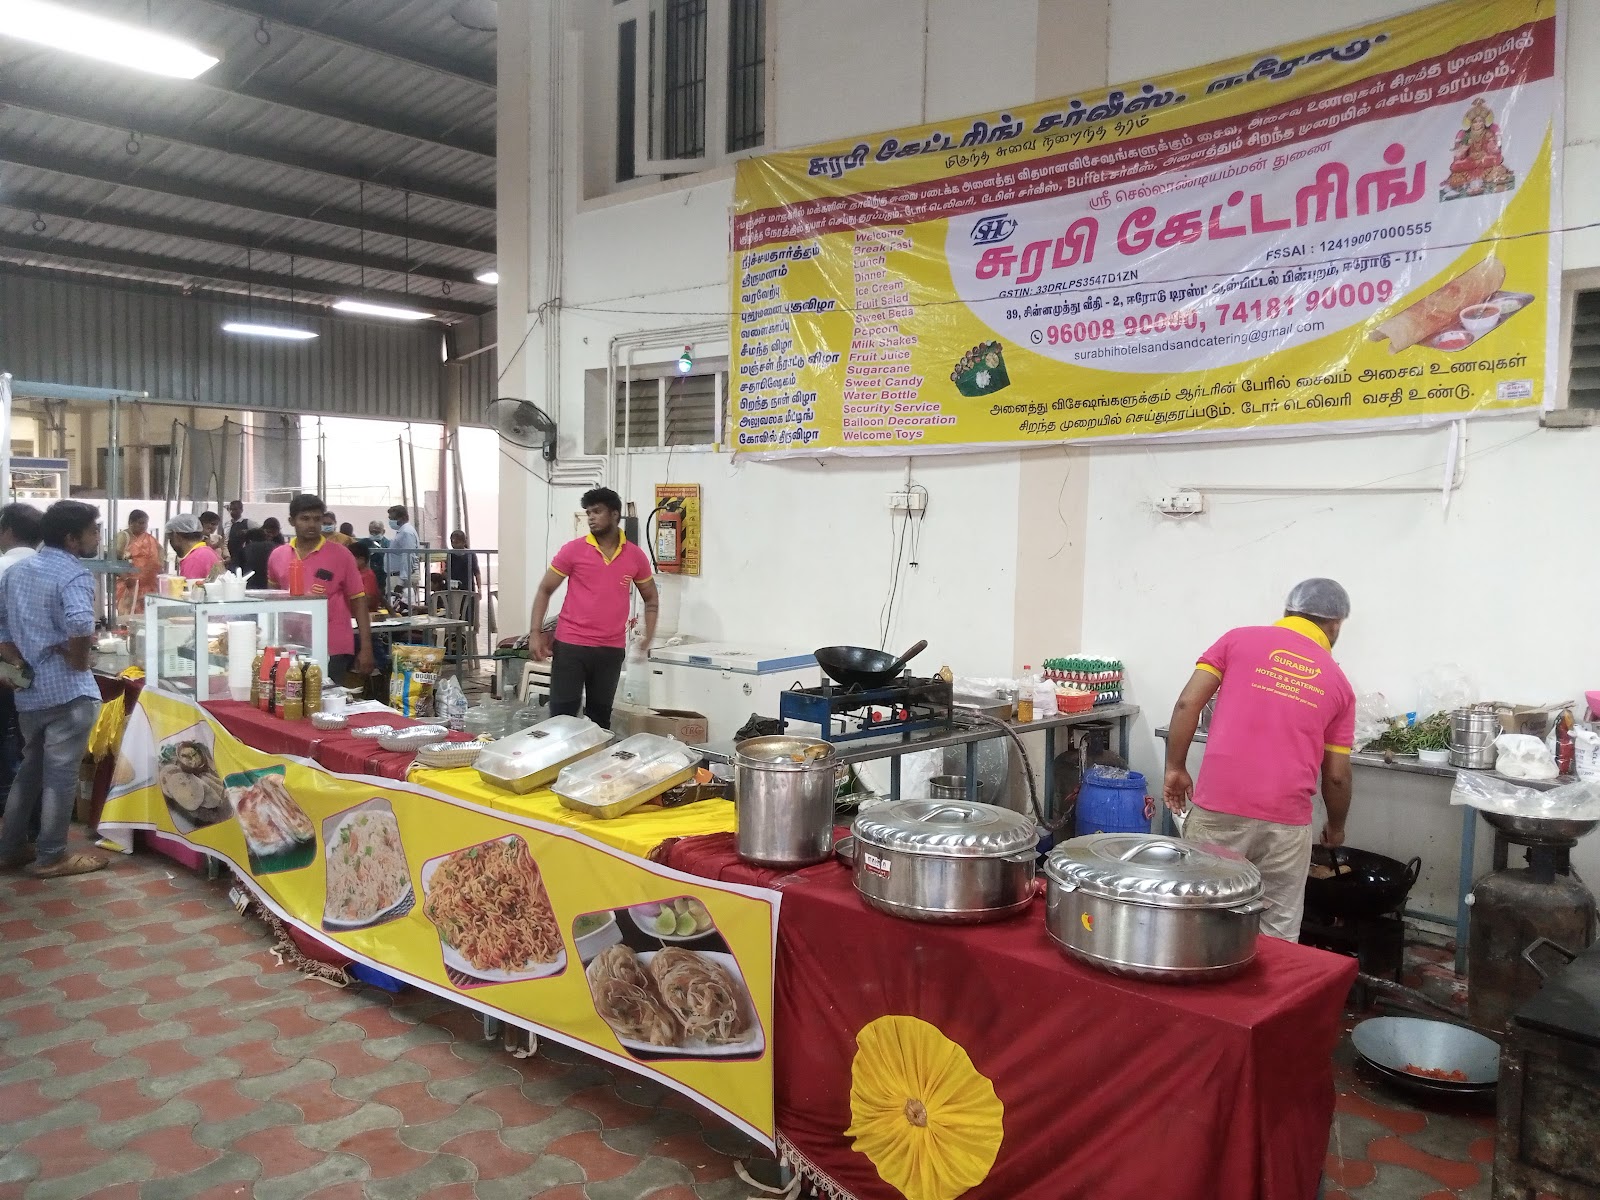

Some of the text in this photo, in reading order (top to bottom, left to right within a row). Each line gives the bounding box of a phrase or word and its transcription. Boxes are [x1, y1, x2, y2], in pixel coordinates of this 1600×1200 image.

[921, 183, 960, 199] படைக்க
[962, 172, 1016, 193] அனைத்து
[1197, 126, 1242, 142] சைவ,
[1248, 107, 1302, 129] அசைவ
[1306, 81, 1385, 113] உணவுகள்
[1390, 62, 1441, 90] சிறந்த
[1447, 31, 1534, 73] முறையில்
[808, 144, 870, 178] சுரபி
[876, 114, 1023, 162] கேட்டரிங்
[905, 202, 927, 216] டோர்
[929, 196, 977, 211] டெலிவரி,
[981, 188, 1016, 204] டேபிள்
[1163, 136, 1243, 167] அனைத்தும்
[1247, 126, 1295, 147] சிறந்த
[1299, 102, 1371, 134] முறையில்
[1375, 84, 1433, 110] செய்து
[1437, 59, 1516, 98] தரப்படும்.
[945, 114, 1150, 168] மிகுந்த சுவை நிறைந்த தரம்
[1272, 139, 1333, 174] துணை
[975, 142, 1427, 285] சுரபி கேட்டரிங்
[856, 228, 904, 243] Welcome
[974, 216, 1013, 242] SHC
[853, 240, 912, 256] Break Fast
[1266, 244, 1306, 261] FSSAI
[1320, 221, 1432, 253] 12419007000555
[853, 256, 885, 269] Lunch
[742, 264, 788, 287] திருமணம்
[855, 270, 886, 283] Dinner
[999, 269, 1139, 299] GSTIN: 33DRLPS3547D1ZN
[742, 284, 780, 304] வரவேற்பு
[855, 281, 903, 296] Ice Cream
[856, 293, 909, 310] Fruit Salad
[1006, 309, 1022, 320] 39,
[1024, 300, 1081, 318] சின்னமுத்து
[1083, 296, 1103, 312] வீதி
[1113, 296, 1124, 307] 2,
[1126, 289, 1167, 306] ஈரோடு
[1169, 283, 1208, 302] டிரஸ்ட்
[741, 304, 782, 323] புதுமனை
[855, 306, 913, 324] Sweet Beda
[1046, 318, 1115, 346] 96008
[1216, 293, 1294, 326] 74181
[1305, 279, 1393, 312] 90009
[741, 319, 790, 338] வளைகாப்பு
[853, 324, 898, 338] Popcorn
[740, 339, 793, 357] சீமந்த விழா
[851, 336, 918, 350] Milk Shakes
[1074, 321, 1325, 361] surabhihotelsandsandcatering@gmailcom
[849, 351, 910, 362] Fruit Juice
[740, 358, 774, 376] மஞ்சள்
[847, 364, 910, 376] Sugarcane
[845, 376, 924, 388] Sweet Candy
[990, 352, 1527, 416] அனைத்து விசேஷங்களுக்கும் ஆர்டரின் பேரில் சைவம் அசைவ உணவுகள்
[740, 390, 817, 411] பிறந்த நாள் விழா
[843, 389, 917, 401] Water Bottle
[843, 402, 940, 415] Security Service
[1019, 418, 1057, 434] சிறந்த
[1060, 412, 1122, 432] முறையில்
[1126, 402, 1235, 425] செய்துதரப்படும்.
[1241, 398, 1279, 415] டோர்
[1284, 392, 1351, 411] டெலிவரி
[1362, 387, 1403, 408] வசதி
[1408, 382, 1475, 402] உண்டு.
[740, 415, 783, 429] அலுவலக
[843, 415, 956, 428] Balloon Decoration
[739, 430, 777, 445] கோவில்
[843, 429, 923, 441] Welcome Toys
[1274, 655, 1315, 674] SURABHI
[1255, 667, 1283, 680] HOTELS
[1290, 679, 1325, 696] CATERING
[1275, 682, 1300, 694] ERODE
